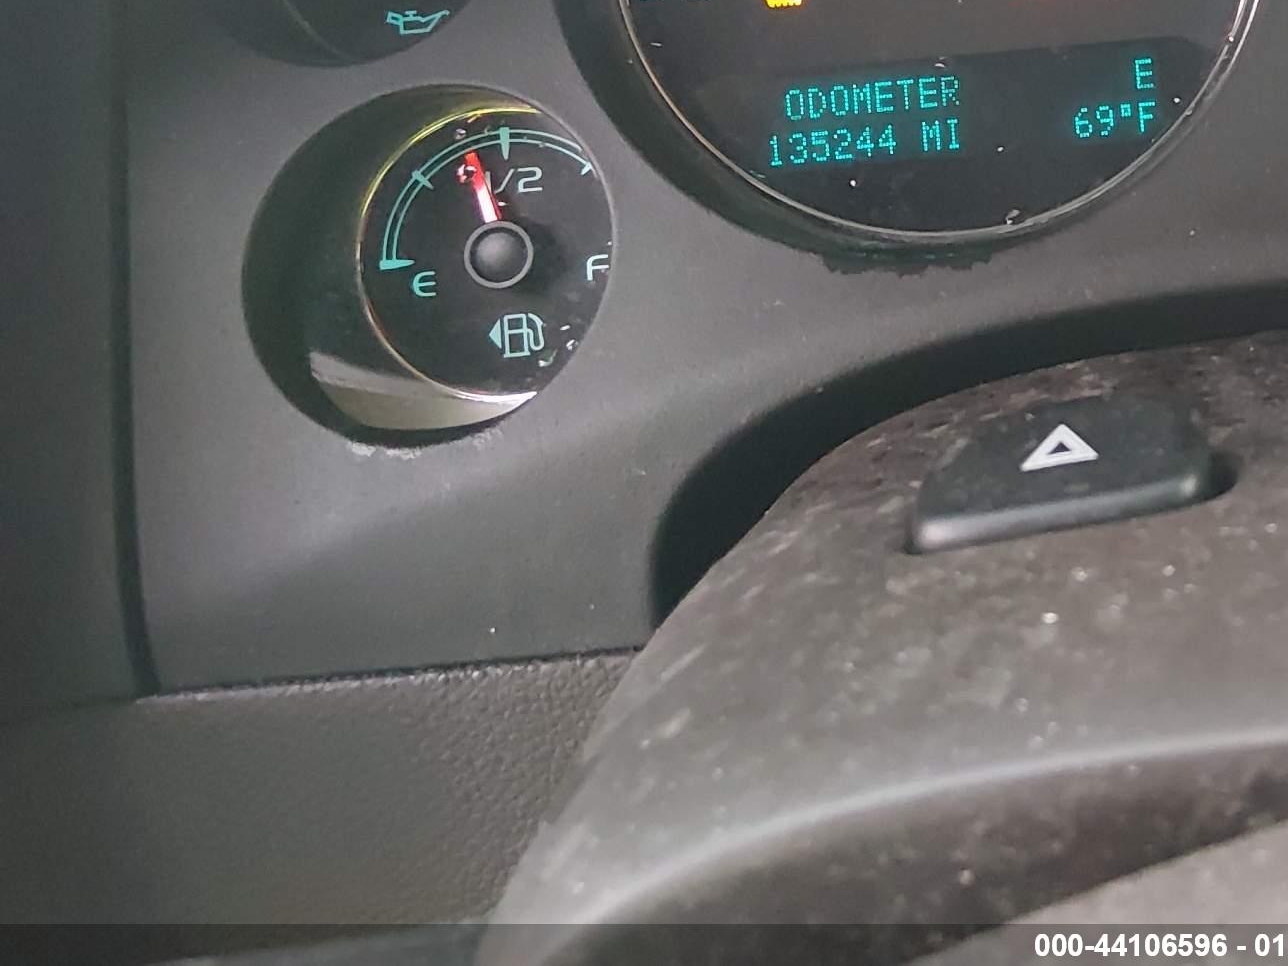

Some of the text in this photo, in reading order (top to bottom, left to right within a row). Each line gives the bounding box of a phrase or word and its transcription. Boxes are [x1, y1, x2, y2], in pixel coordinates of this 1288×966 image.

[1134, 57, 1155, 90] E
[784, 75, 960, 121] ODOMETER
[769, 118, 960, 167] 135244 MI
[411, 270, 437, 297] E
[586, 254, 610, 281] F
